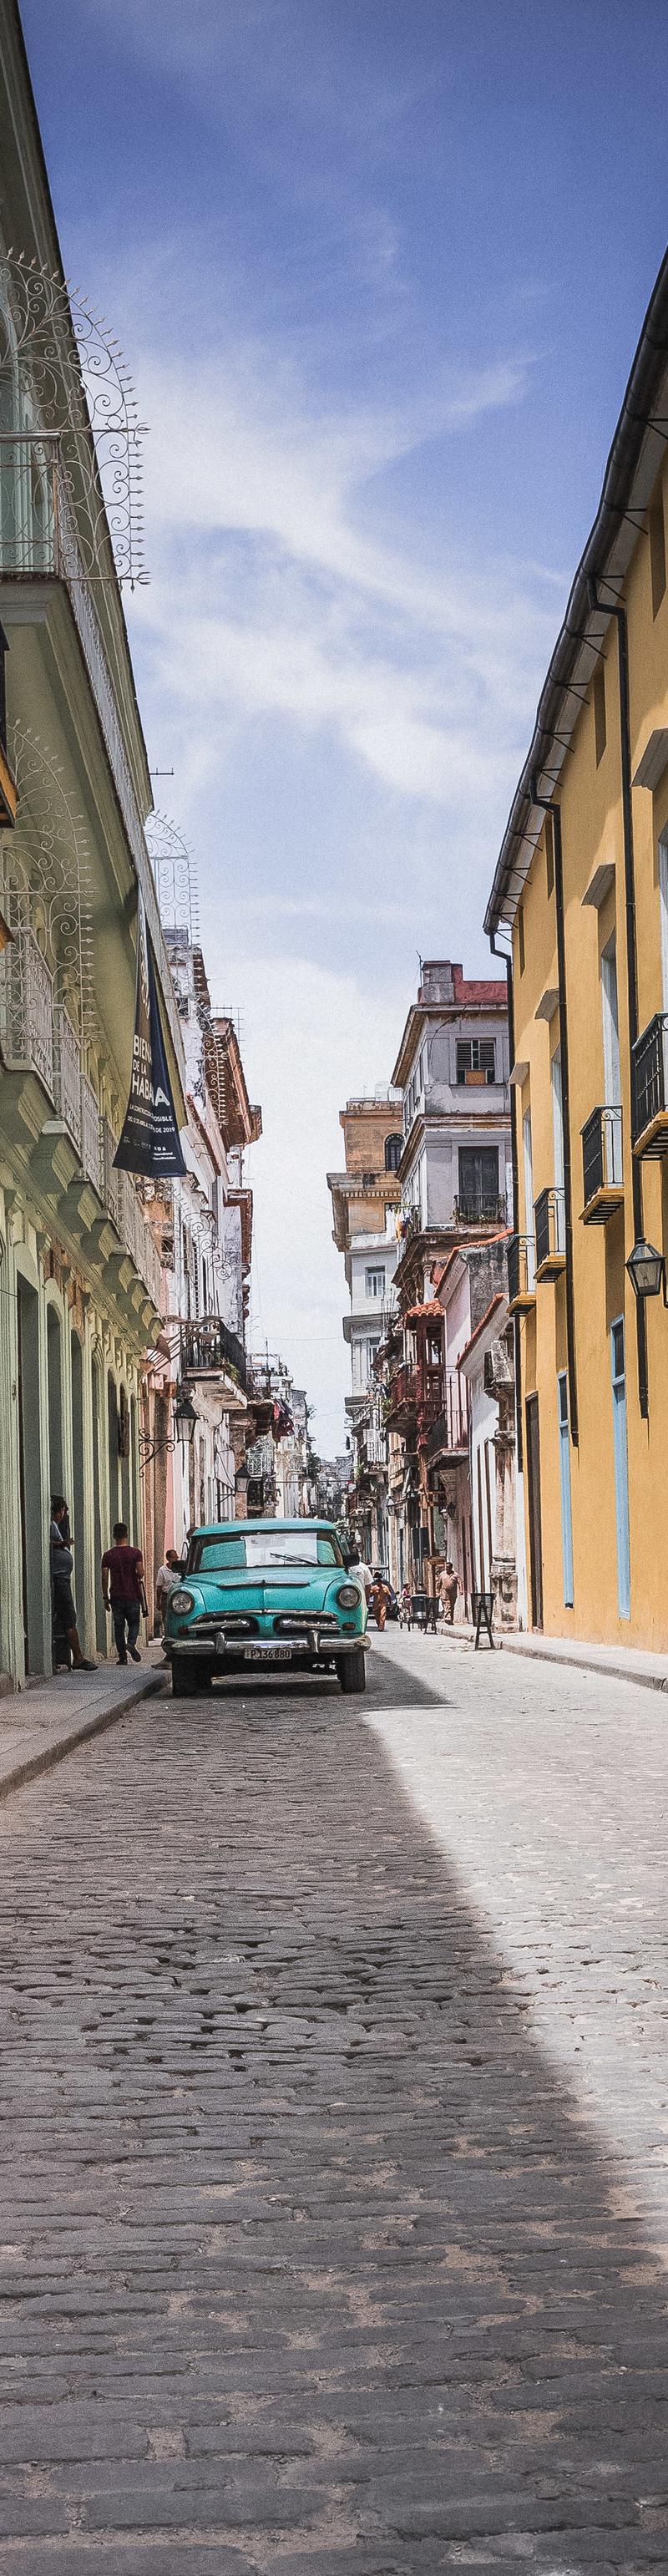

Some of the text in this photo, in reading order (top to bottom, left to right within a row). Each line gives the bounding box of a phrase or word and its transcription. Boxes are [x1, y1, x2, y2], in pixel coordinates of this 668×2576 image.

[134, 1035, 153, 1064] BIEN
[133, 1059, 147, 1076] DE LA
[132, 1072, 170, 1107] HABAA
